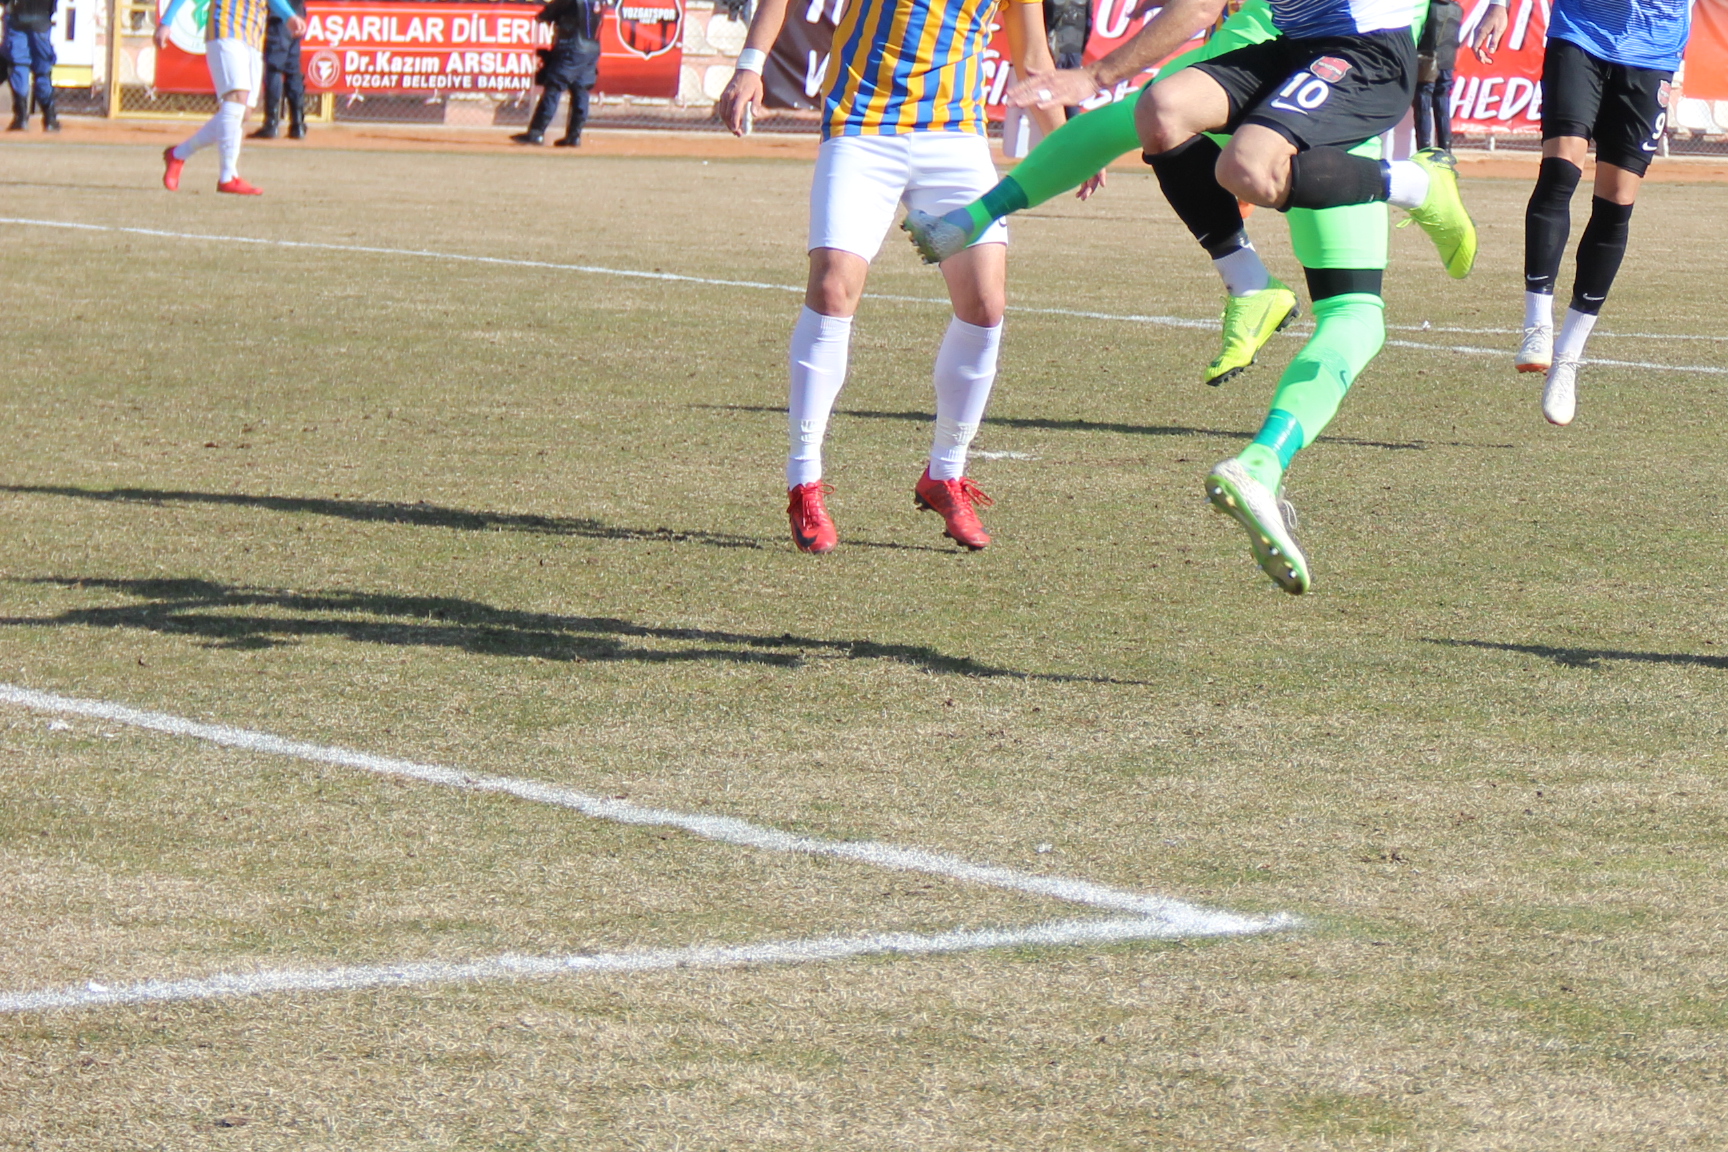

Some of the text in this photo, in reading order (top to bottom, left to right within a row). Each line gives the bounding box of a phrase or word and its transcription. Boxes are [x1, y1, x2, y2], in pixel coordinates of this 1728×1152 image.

[304, 15, 445, 47] AŞARILAR
[345, 50, 440, 73] Dr.Kazım
[345, 73, 531, 91] YOZGAT BELEDİYE BAŞKAN
[1279, 72, 1329, 109] 10
[1652, 112, 1667, 140] 9
